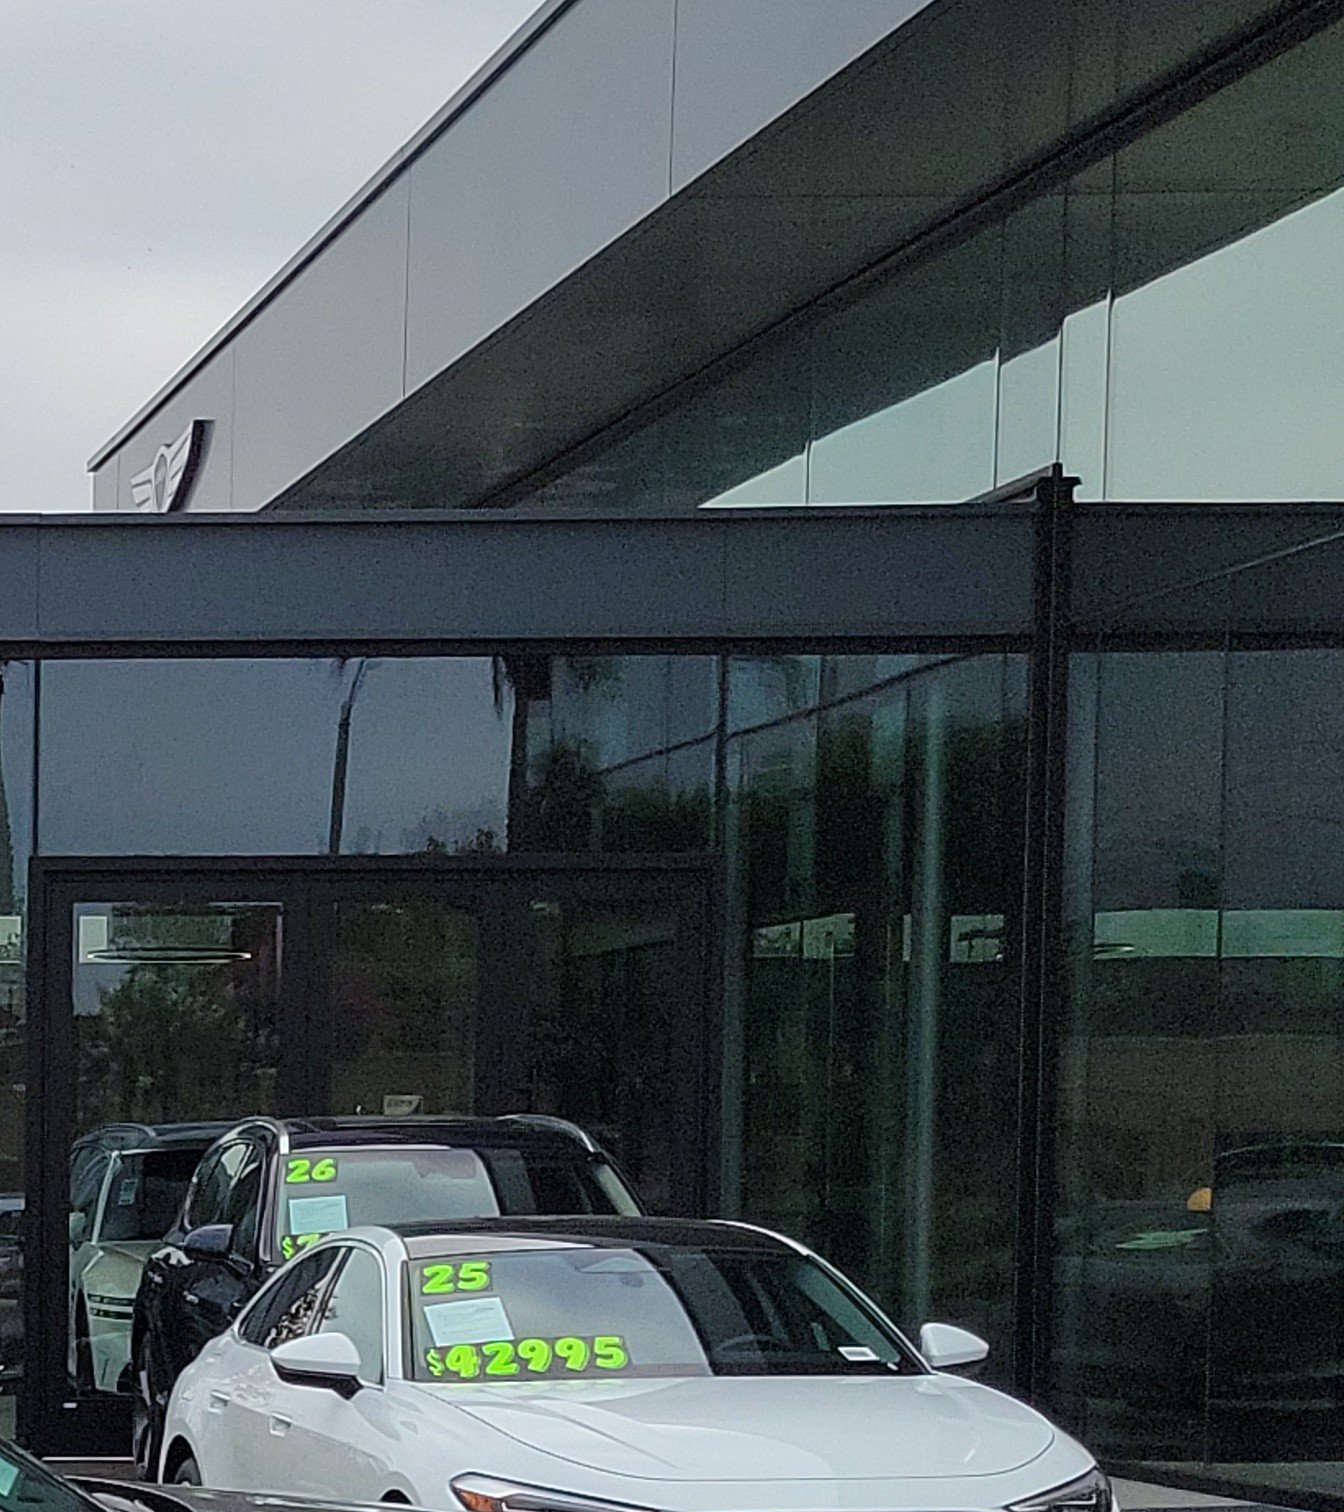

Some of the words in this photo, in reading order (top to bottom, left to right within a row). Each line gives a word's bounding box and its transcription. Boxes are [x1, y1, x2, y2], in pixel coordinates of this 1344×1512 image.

[286, 1158, 337, 1183] 26
[422, 1260, 491, 1295] 25
[425, 1335, 628, 1379] $42995
